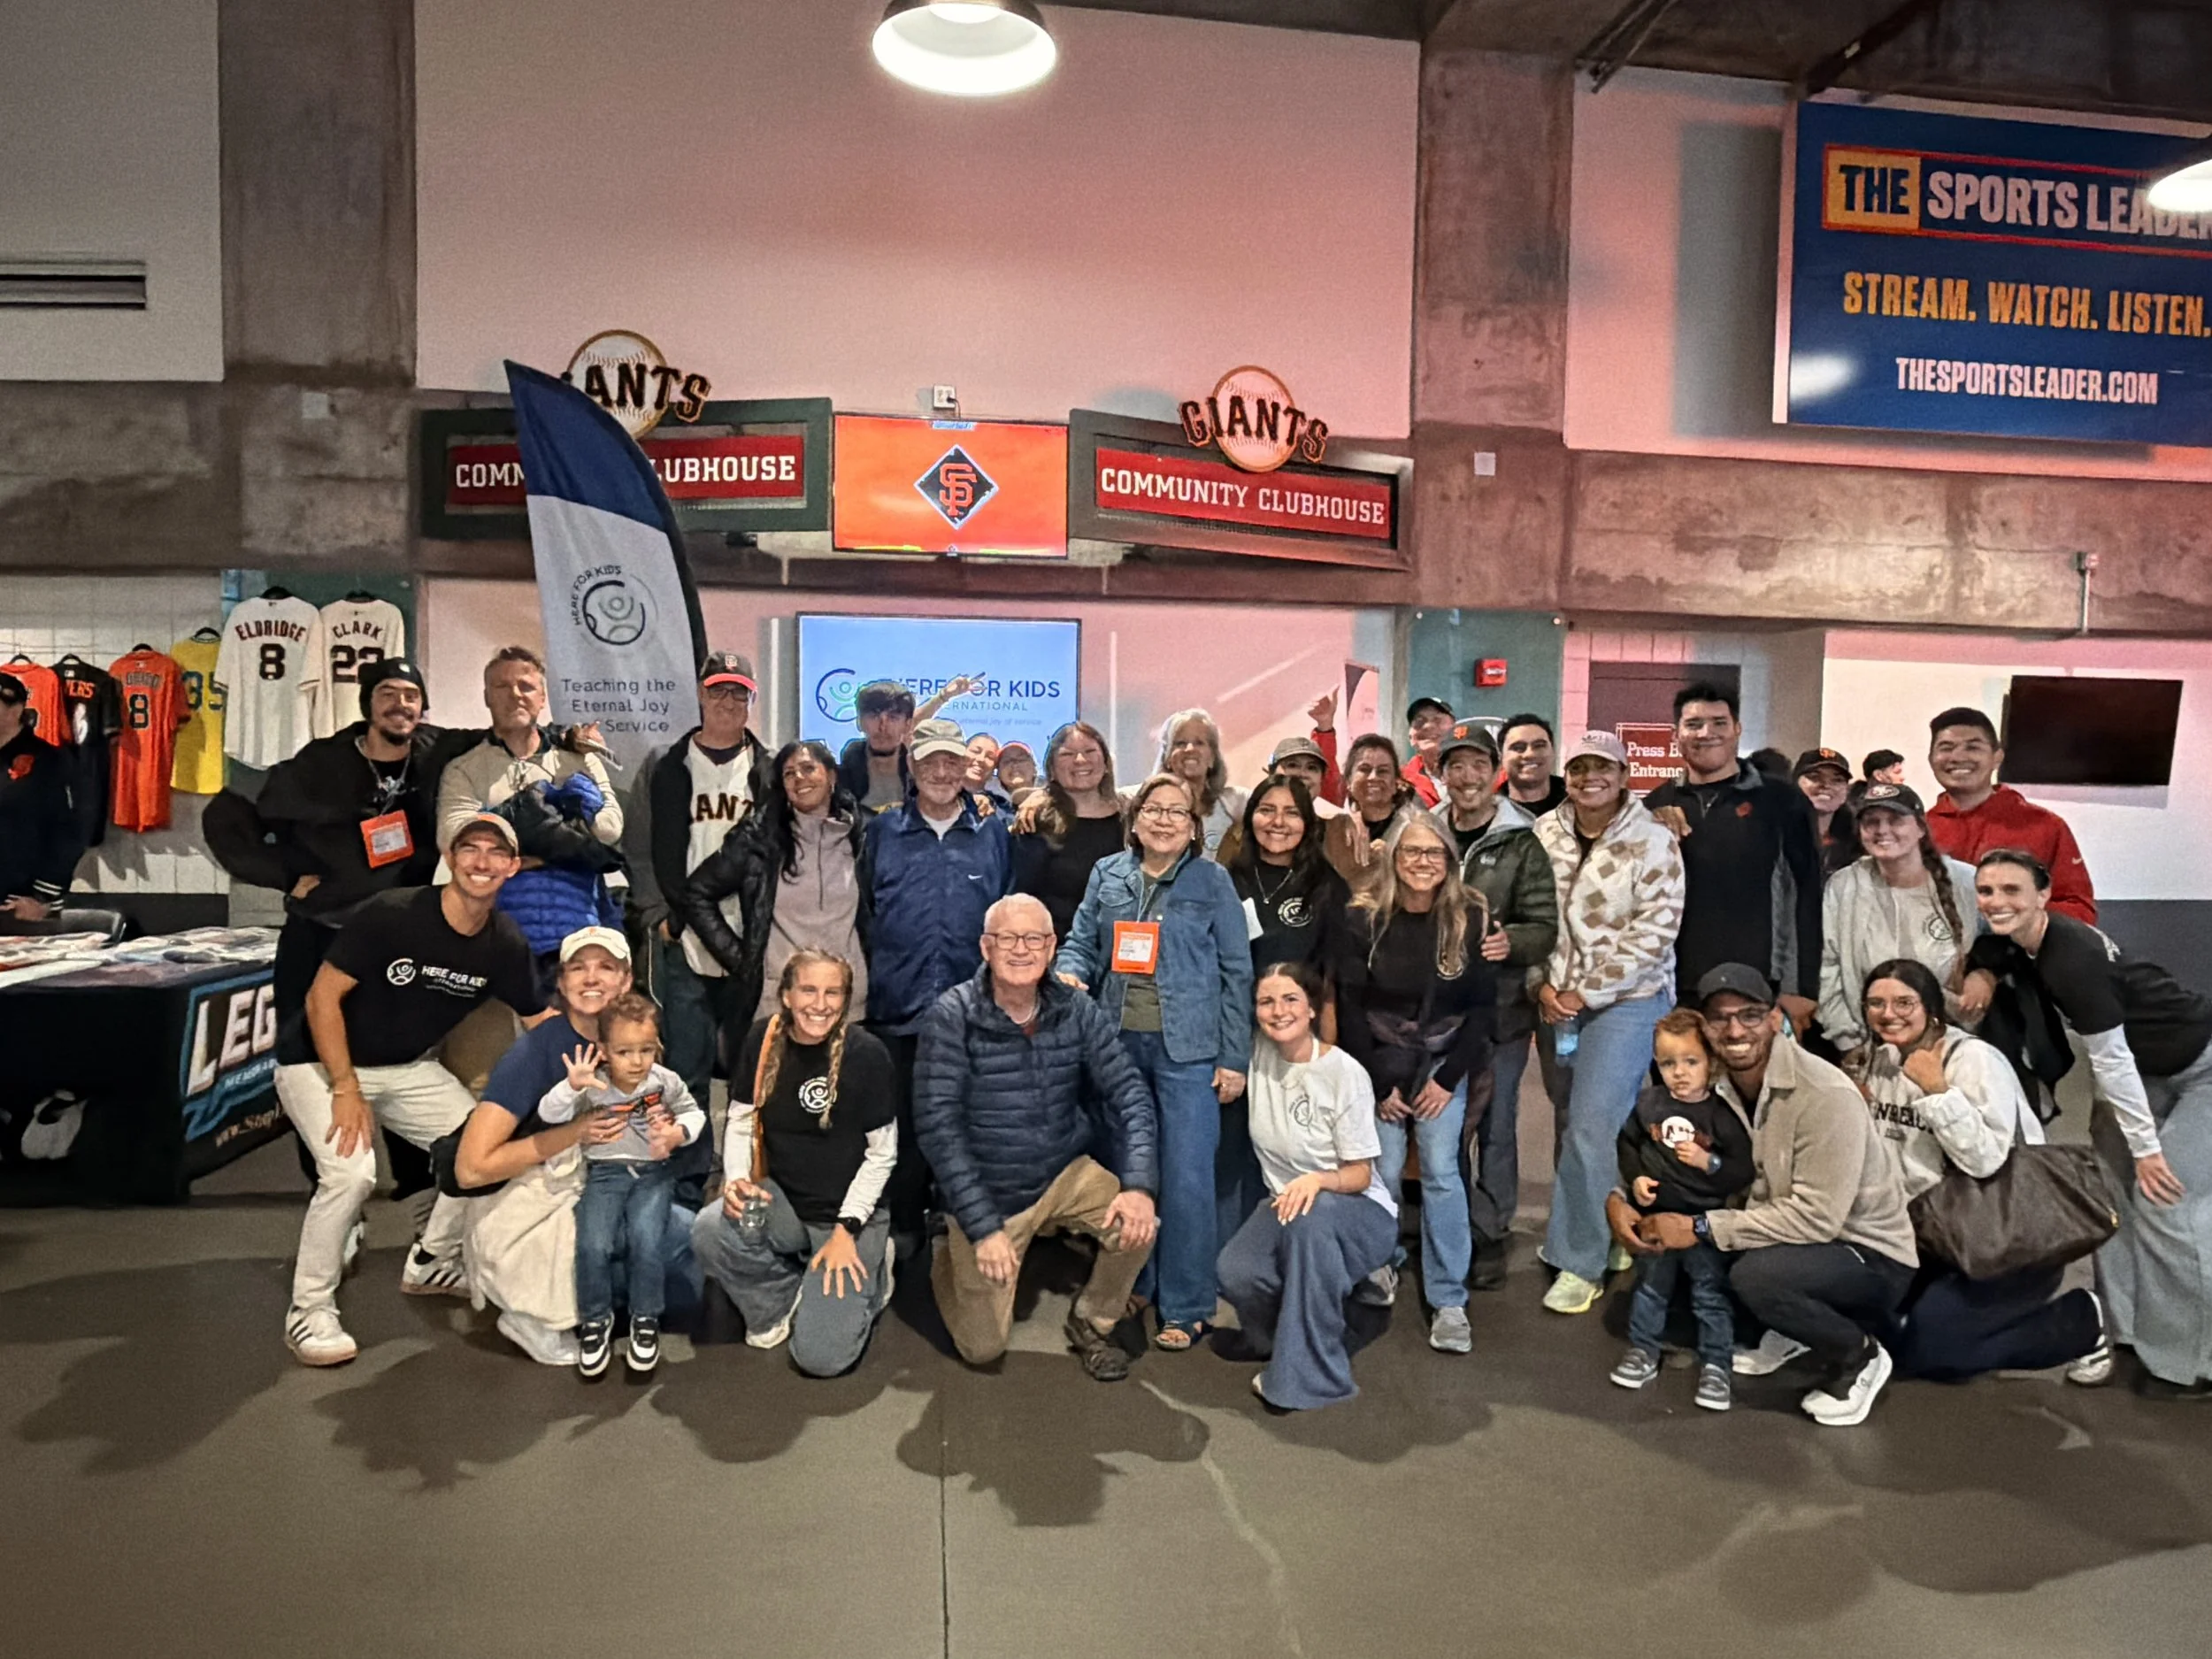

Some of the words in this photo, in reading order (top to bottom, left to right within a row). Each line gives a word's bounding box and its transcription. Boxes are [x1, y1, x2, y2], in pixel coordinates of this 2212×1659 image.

[1839, 163, 1912, 215] THE
[1926, 170, 2079, 230] SPORTS
[2085, 183, 2212, 240] LEA
[1843, 270, 1978, 323] STREAM.
[1987, 280, 2099, 331] WATCH.
[2107, 289, 2212, 338] LISTEN.
[584, 362, 712, 423] ANTS
[1895, 357, 2159, 405] THESPORTSLEADER.COM
[1179, 395, 1328, 464] GIANTS
[455, 462, 526, 488] COMM
[649, 454, 796, 483] UBHOUSE
[1101, 467, 1248, 509] COMMUNITY
[1257, 487, 1386, 526] CLUBHOUSE
[234, 619, 307, 642] ELDRIDGE
[331, 620, 383, 641] CLARK
[258, 642, 286, 680] 8
[561, 679, 639, 695] Teaching
[647, 679, 676, 692] the
[1009, 680, 1061, 698] KIDS
[129, 693, 150, 730] 8
[572, 699, 634, 713] Eternal
[639, 699, 670, 716] Joy
[605, 719, 670, 733] Service
[1626, 741, 1665, 757] Press
[1629, 762, 1684, 778] Entranc
[421, 965, 449, 979] HERE
[449, 972, 468, 985] FOR
[187, 983, 277, 1097] LEG
